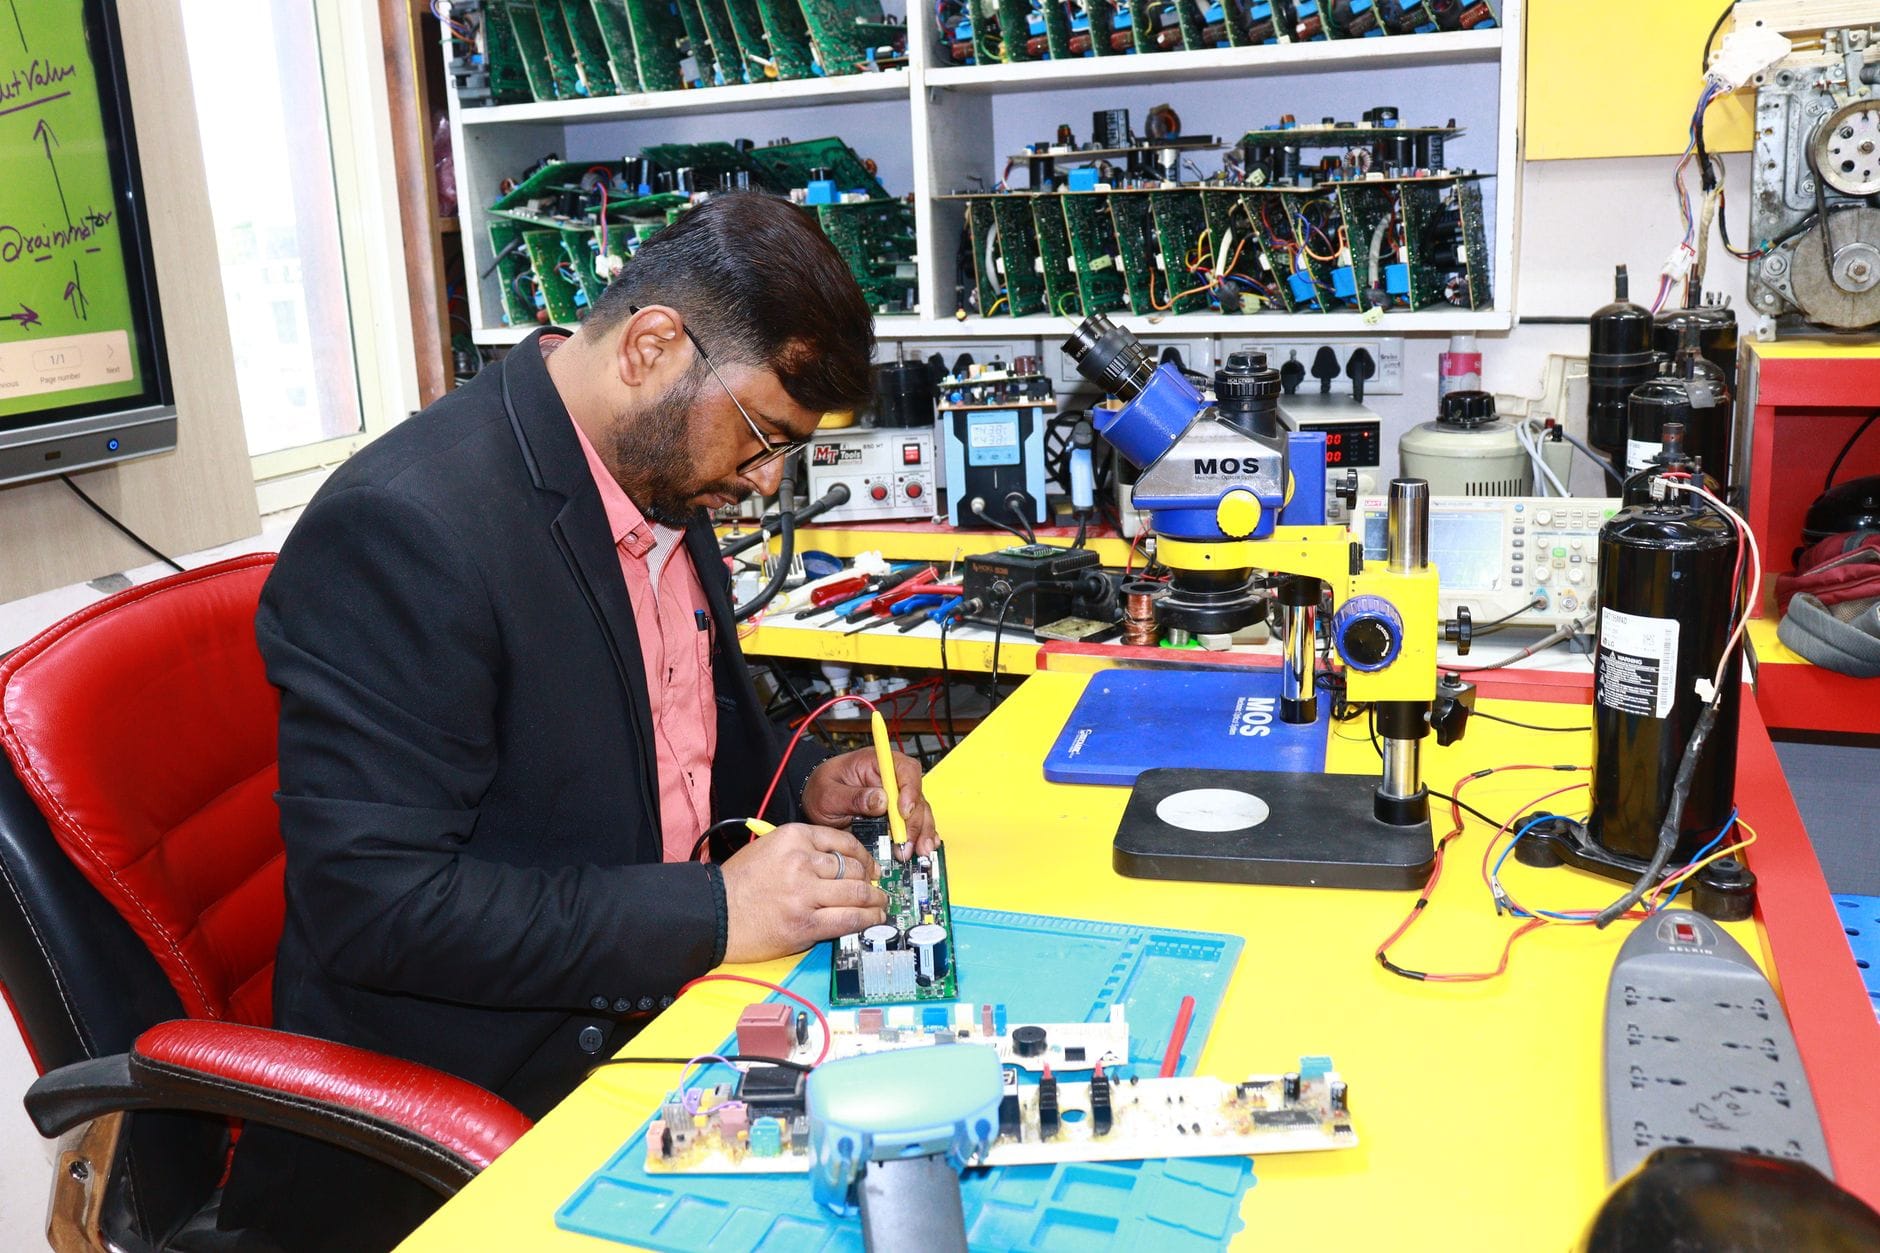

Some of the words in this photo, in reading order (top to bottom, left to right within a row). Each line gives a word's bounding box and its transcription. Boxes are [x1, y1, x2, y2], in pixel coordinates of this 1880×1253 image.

[40, 375, 57, 384] Page
[57, 372, 80, 381] number
[1194, 457, 1260, 475] MOS
[1239, 697, 1276, 737] MOS
